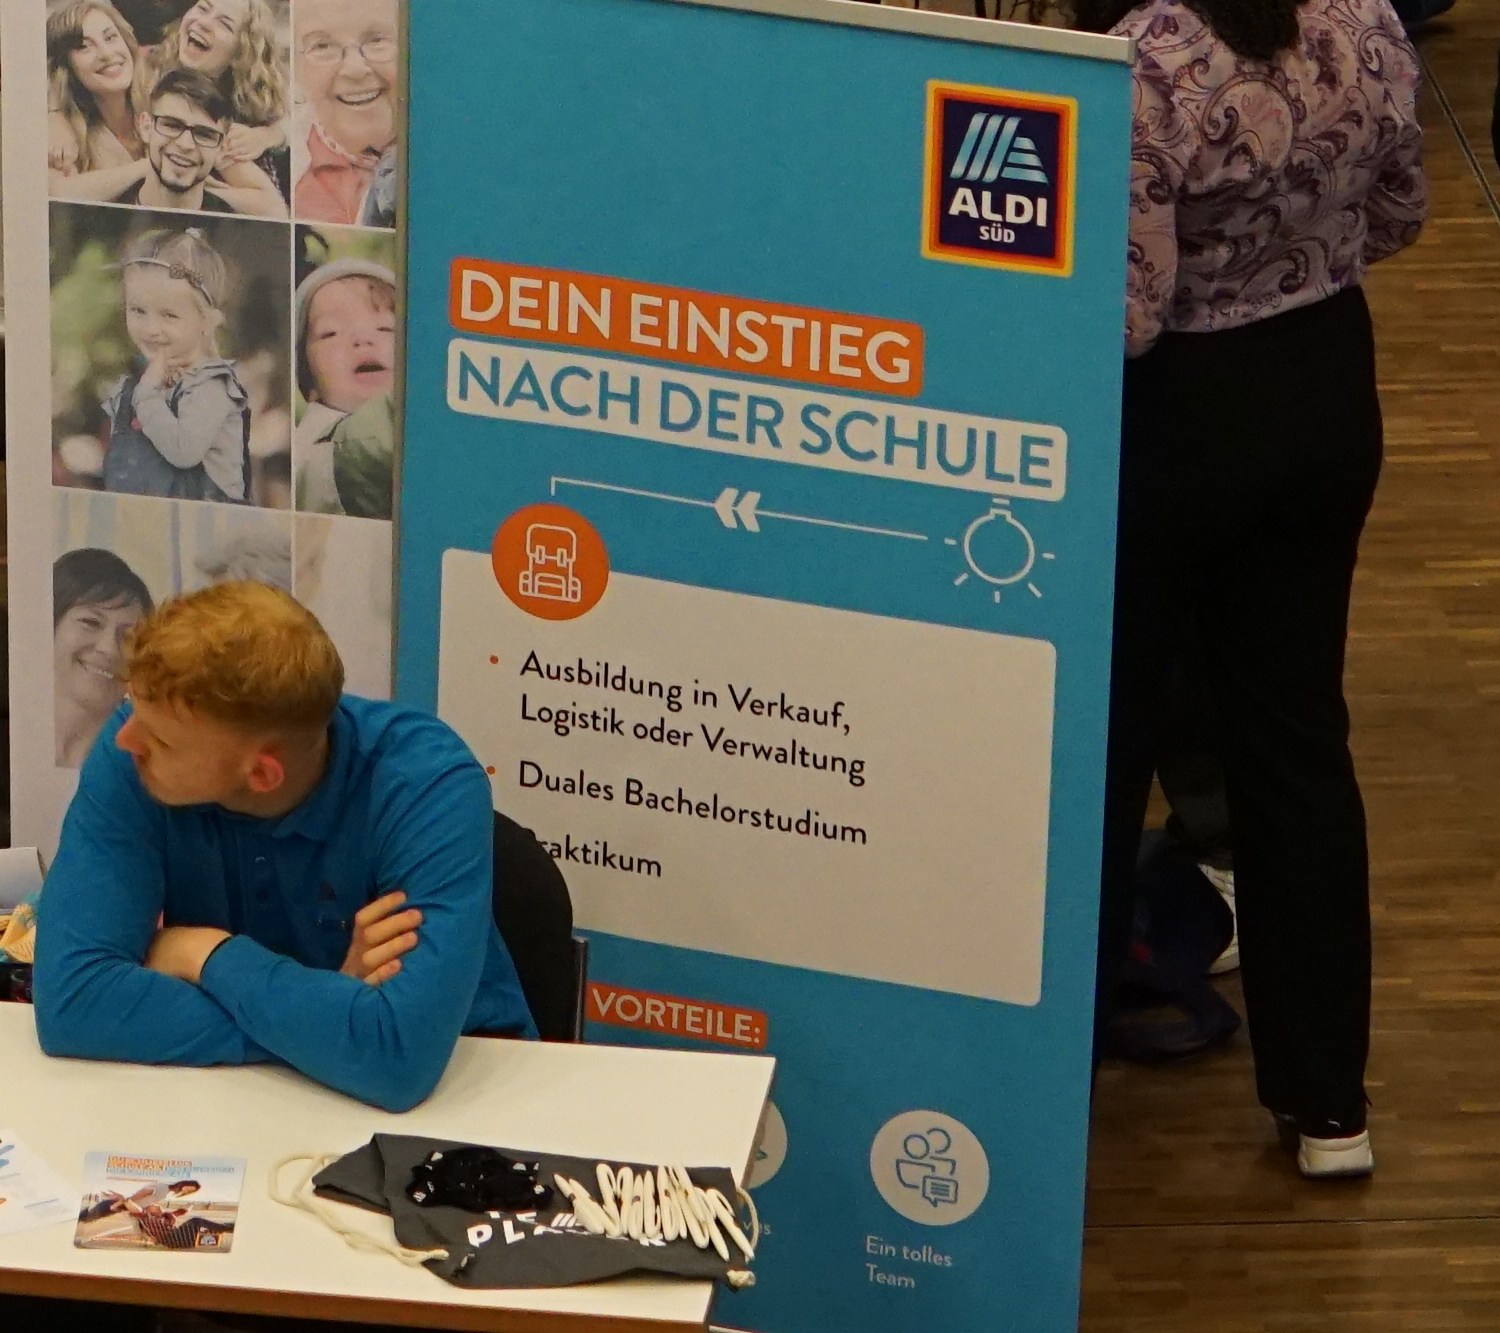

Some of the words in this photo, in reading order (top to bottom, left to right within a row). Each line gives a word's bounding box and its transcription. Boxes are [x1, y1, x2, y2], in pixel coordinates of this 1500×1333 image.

[948, 187, 1047, 227] ALDI
[978, 222, 1016, 244] SÜD
[460, 269, 611, 339] DEIN
[630, 292, 911, 384] EINSTIEG
[458, 351, 640, 425] NACH
[660, 381, 784, 448] DER
[800, 403, 1055, 489] SCHULE
[520, 650, 682, 712] Ausbildung
[693, 679, 718, 709] in
[728, 684, 851, 735] Verkauf,
[521, 694, 624, 736] Logistik
[633, 717, 693, 747] oder
[701, 724, 866, 786] Verwaltung
[520, 760, 614, 801] Duales
[625, 779, 867, 844] Bachelorstudium
[537, 835, 662, 878] raktikum
[592, 988, 761, 1044] VORTEILE:
[866, 1234, 896, 1260] Ein
[902, 1244, 953, 1268] tolles
[866, 1263, 916, 1289] Team
